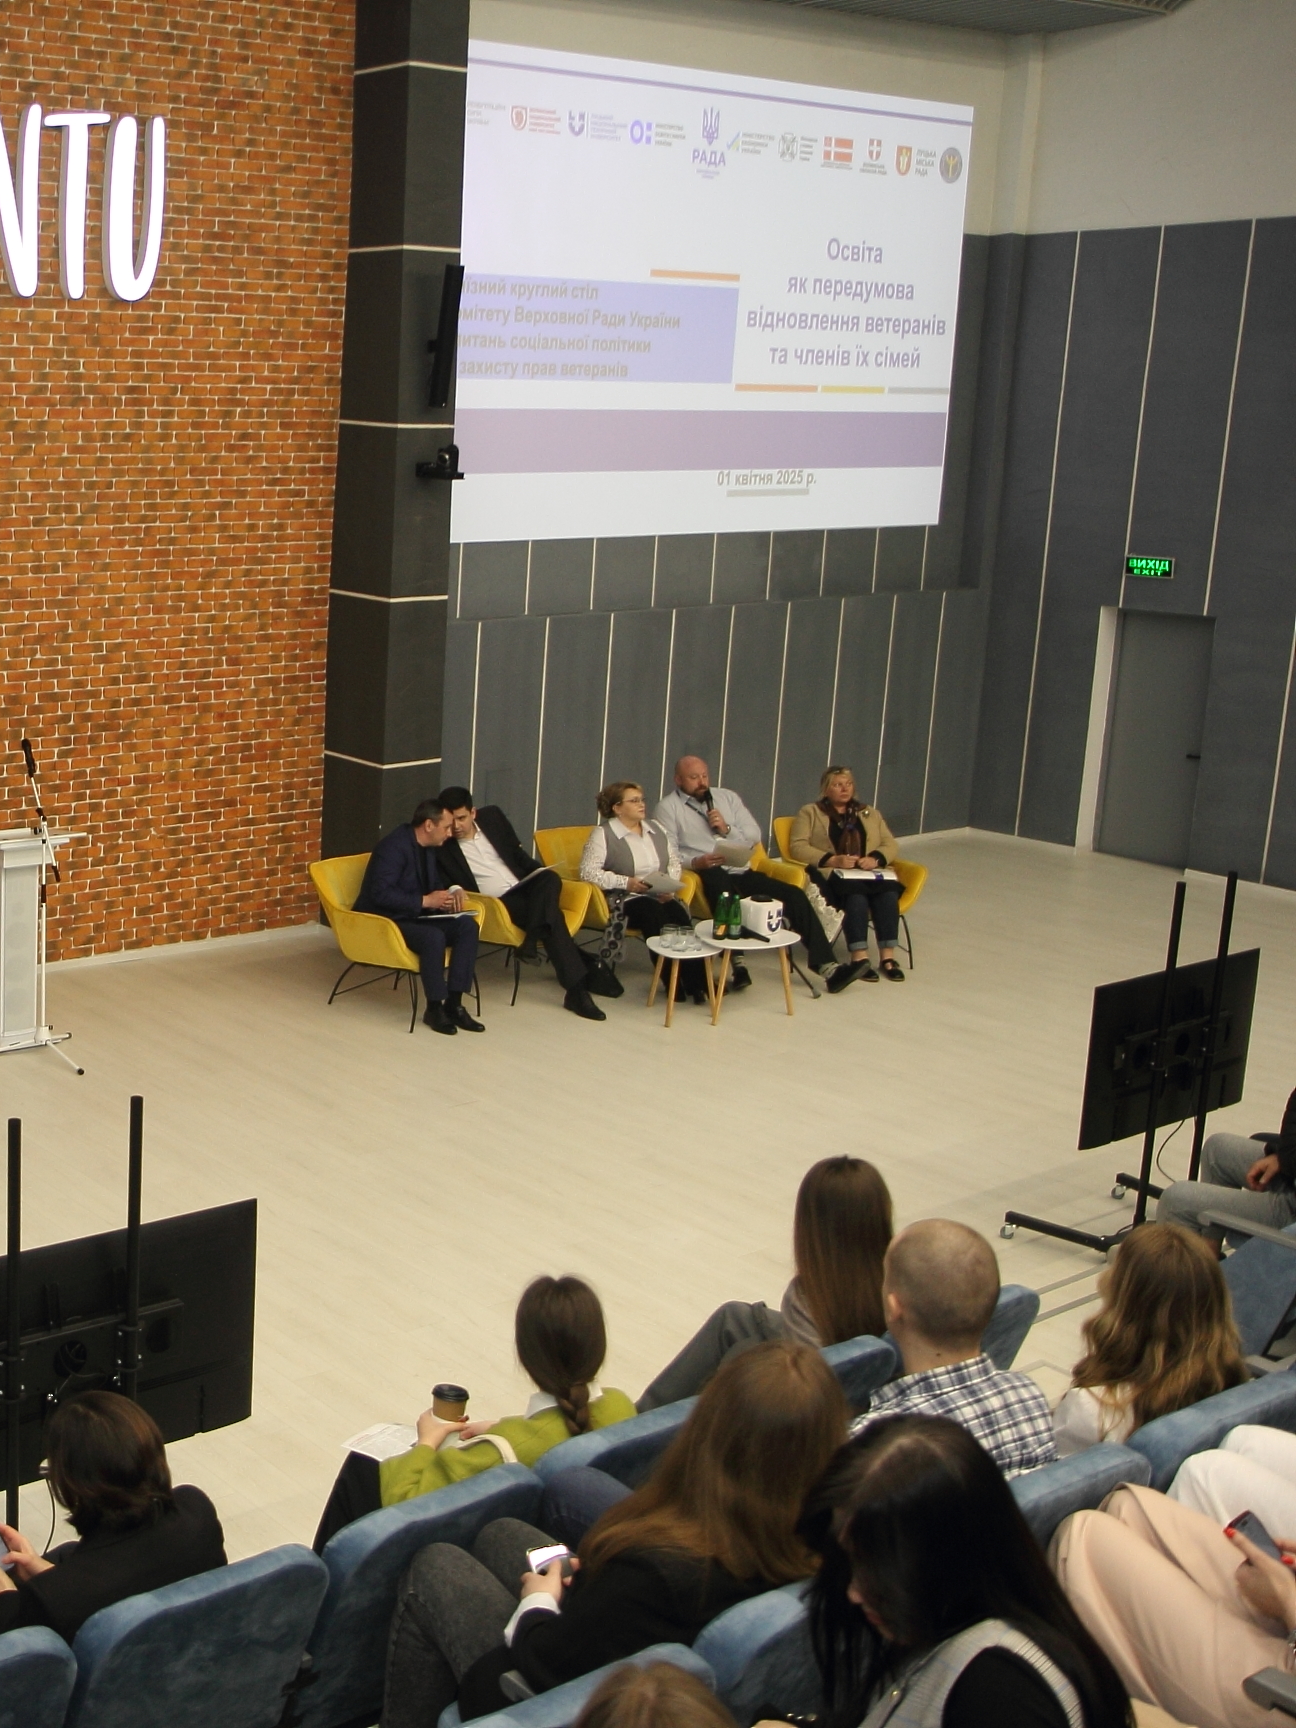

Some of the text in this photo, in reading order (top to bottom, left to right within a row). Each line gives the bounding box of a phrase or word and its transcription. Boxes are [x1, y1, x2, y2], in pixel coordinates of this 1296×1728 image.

[692, 149, 726, 167] РАДА
[826, 237, 883, 264] Освіта
[462, 276, 599, 301] їзний круглий стіл
[787, 276, 914, 303] як передумова
[514, 305, 589, 327] Верховної
[592, 309, 626, 328] Ради
[629, 310, 681, 330] України
[746, 305, 946, 339] відновлення ветеранів
[510, 333, 589, 352] соціальної
[591, 335, 651, 353] політики
[769, 344, 921, 368] та членів їх сімей
[459, 360, 628, 379] захисту прав ветеранів
[717, 469, 817, 488] 01 квітня 2025 р.
[1129, 559, 1169, 571] ВИХІД
[1134, 568, 1163, 576] EXIT
